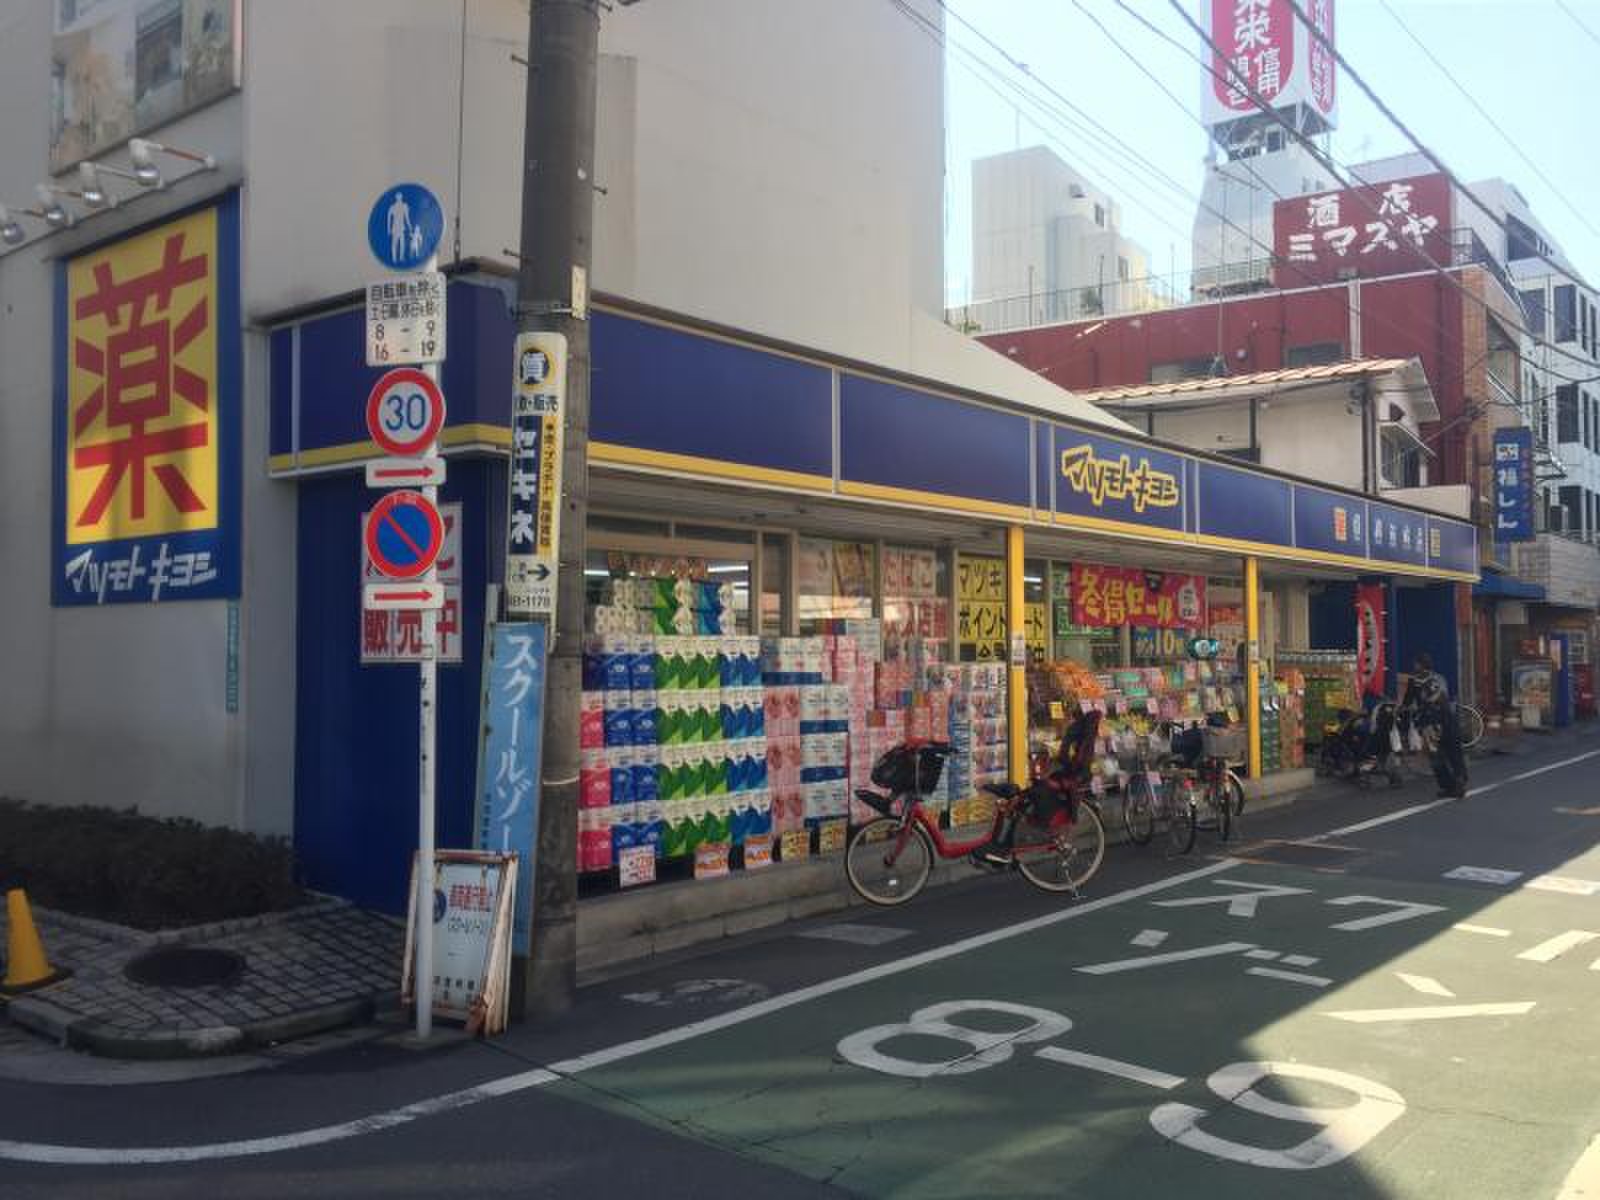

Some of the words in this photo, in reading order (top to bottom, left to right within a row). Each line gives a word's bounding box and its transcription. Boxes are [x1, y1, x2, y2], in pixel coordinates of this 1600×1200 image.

[375, 324, 384, 341] 8
[426, 320, 435, 336] 9
[375, 343, 388, 361] 16
[421, 340, 435, 357] 19
[75, 232, 208, 527] 薬
[384, 396, 426, 431] 30
[1062, 443, 1179, 512] マツモトキヨシ
[65, 543, 218, 604] マツモトキヨシ
[960, 563, 1002, 596] マツキ
[960, 604, 1043, 638] ポイントード
[495, 633, 538, 854] スクールゾー
